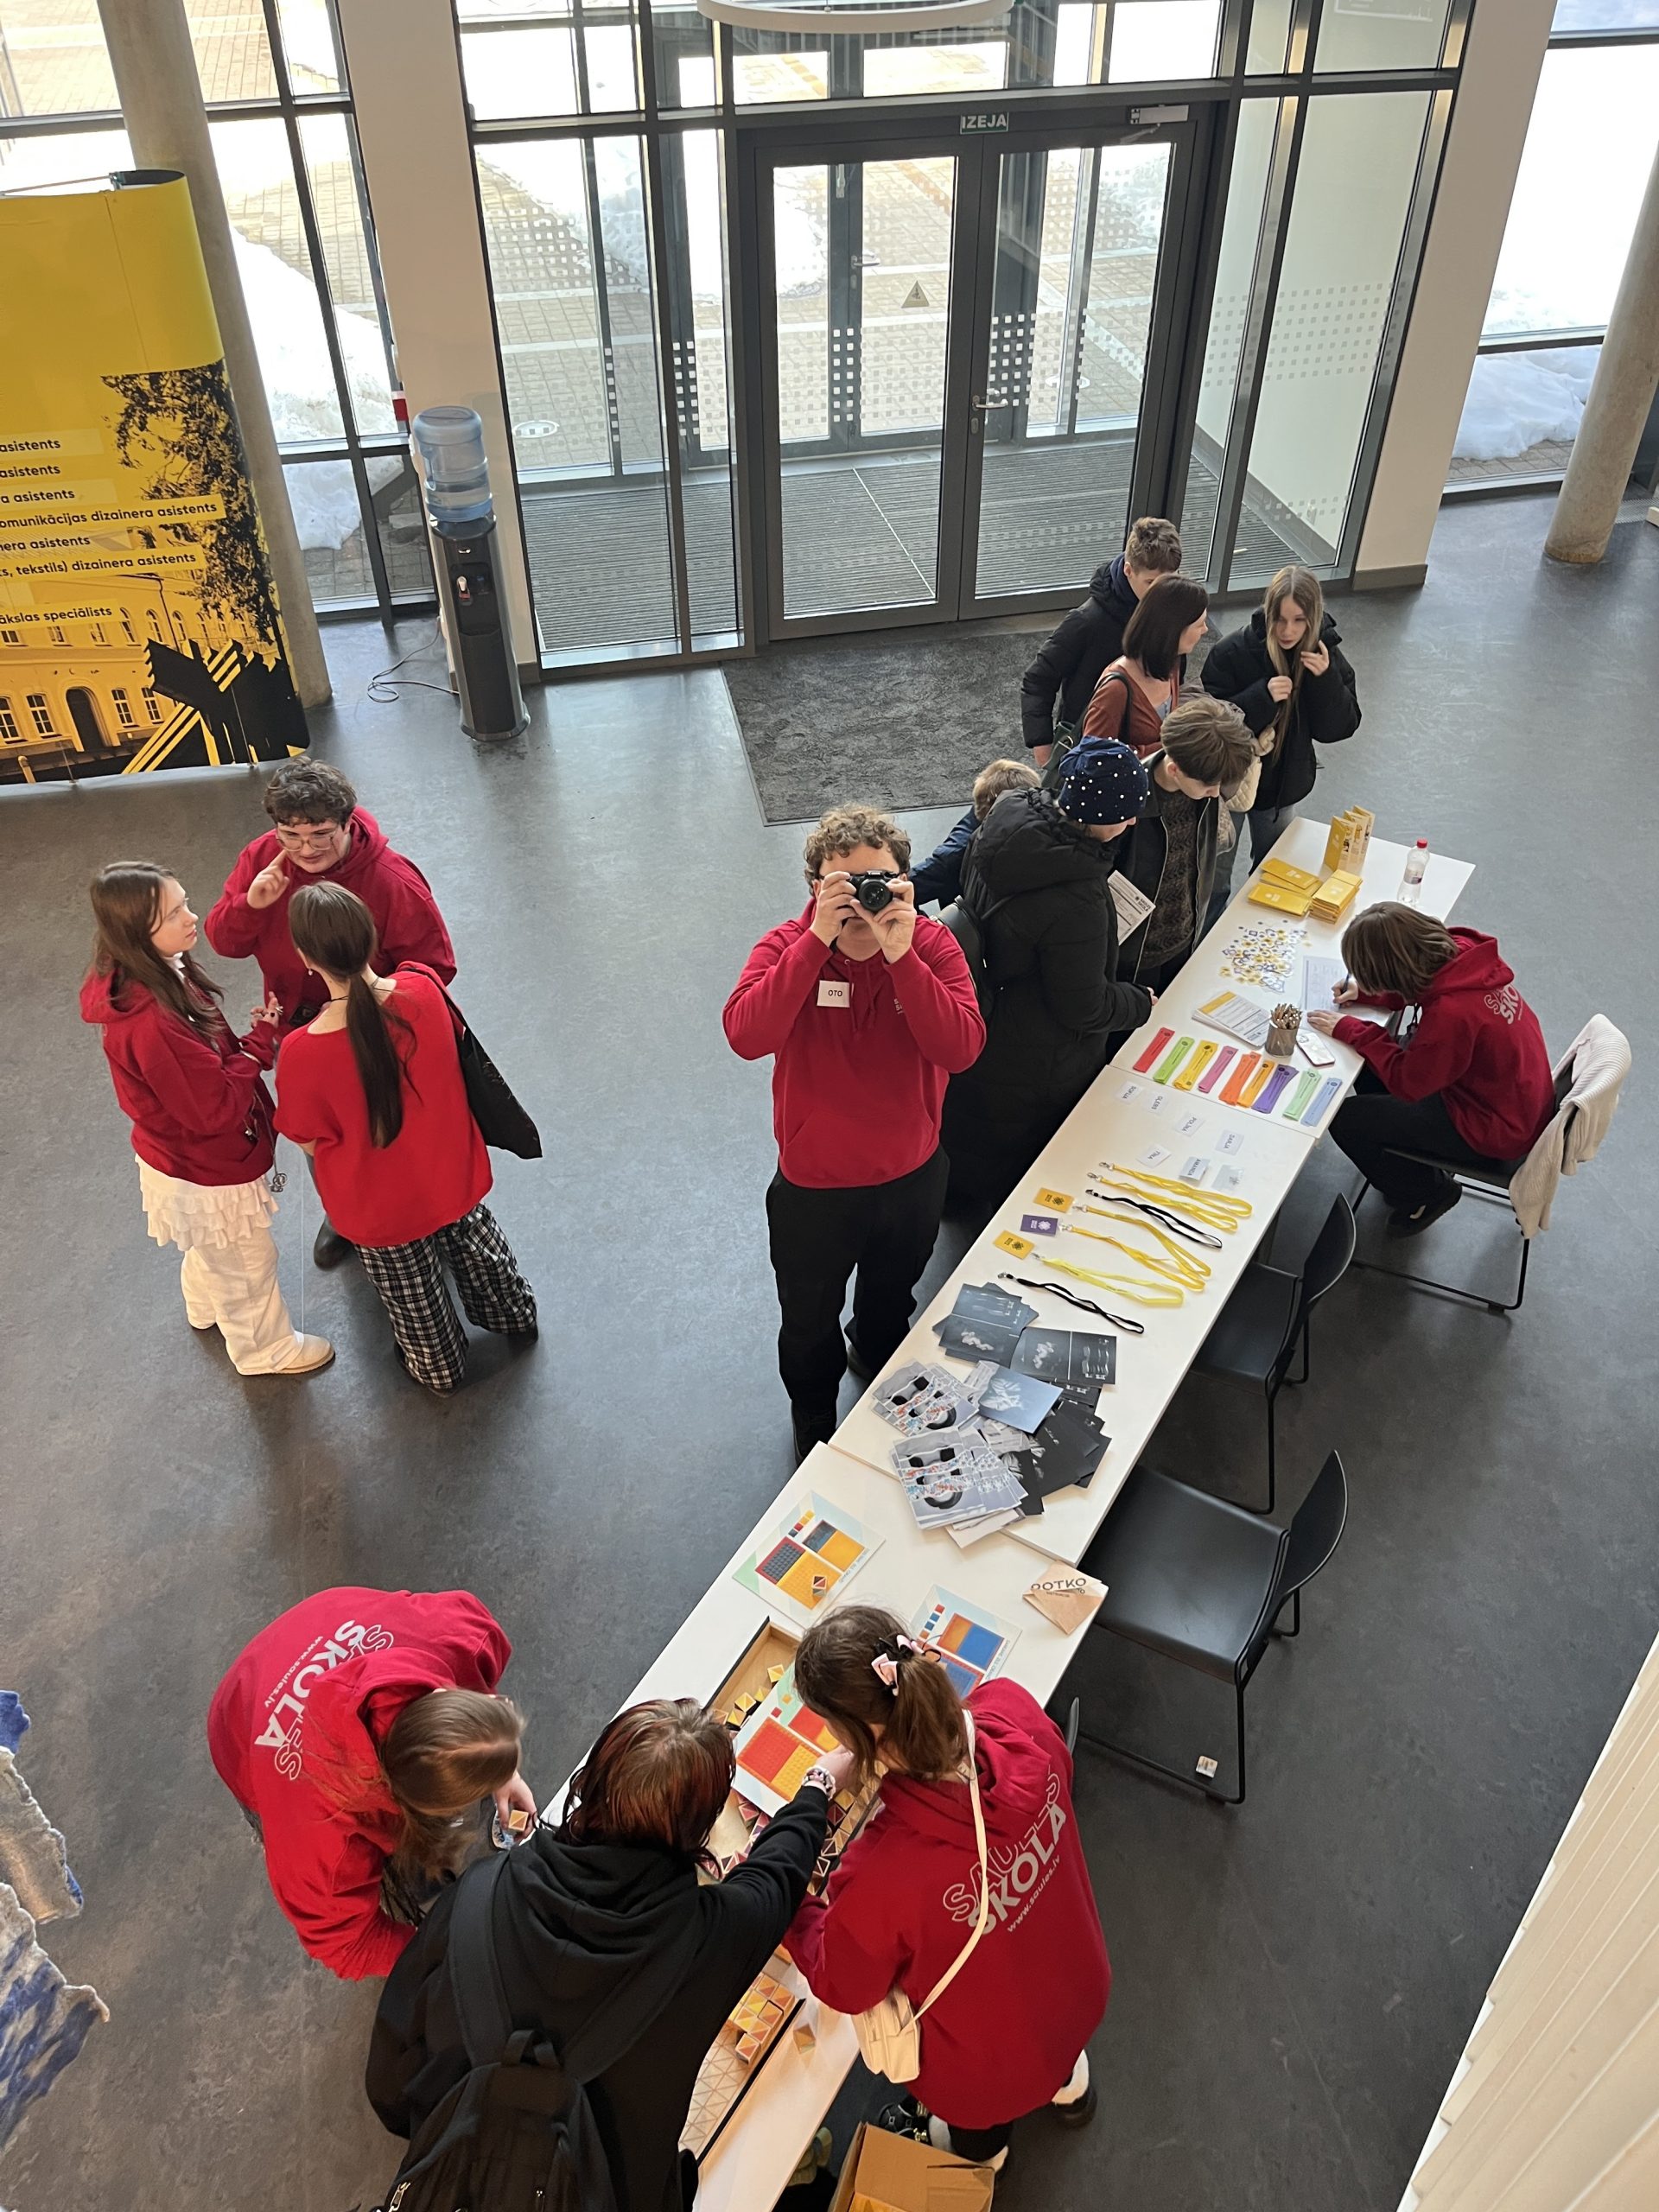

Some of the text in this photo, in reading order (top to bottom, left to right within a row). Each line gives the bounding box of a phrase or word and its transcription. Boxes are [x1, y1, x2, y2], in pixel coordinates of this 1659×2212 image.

[962, 113, 1007, 129] IZEJA
[0, 439, 60, 452] asistents
[0, 465, 60, 478] asistents
[14, 490, 75, 502] asistents
[91, 509, 153, 521] dizainera
[157, 503, 217, 517] asistents
[30, 537, 90, 549] asistents
[16, 561, 67, 575] tekstils)
[72, 559, 133, 571] dizainera
[137, 553, 196, 567] asistents
[43, 607, 112, 622] speciālists
[264, 1636, 324, 1708] www.saules.lv
[254, 1619, 366, 1748] SKOLA
[968, 1802, 1067, 1935] SKOLA
[1007, 1854, 1060, 1933] www.saules.lv
